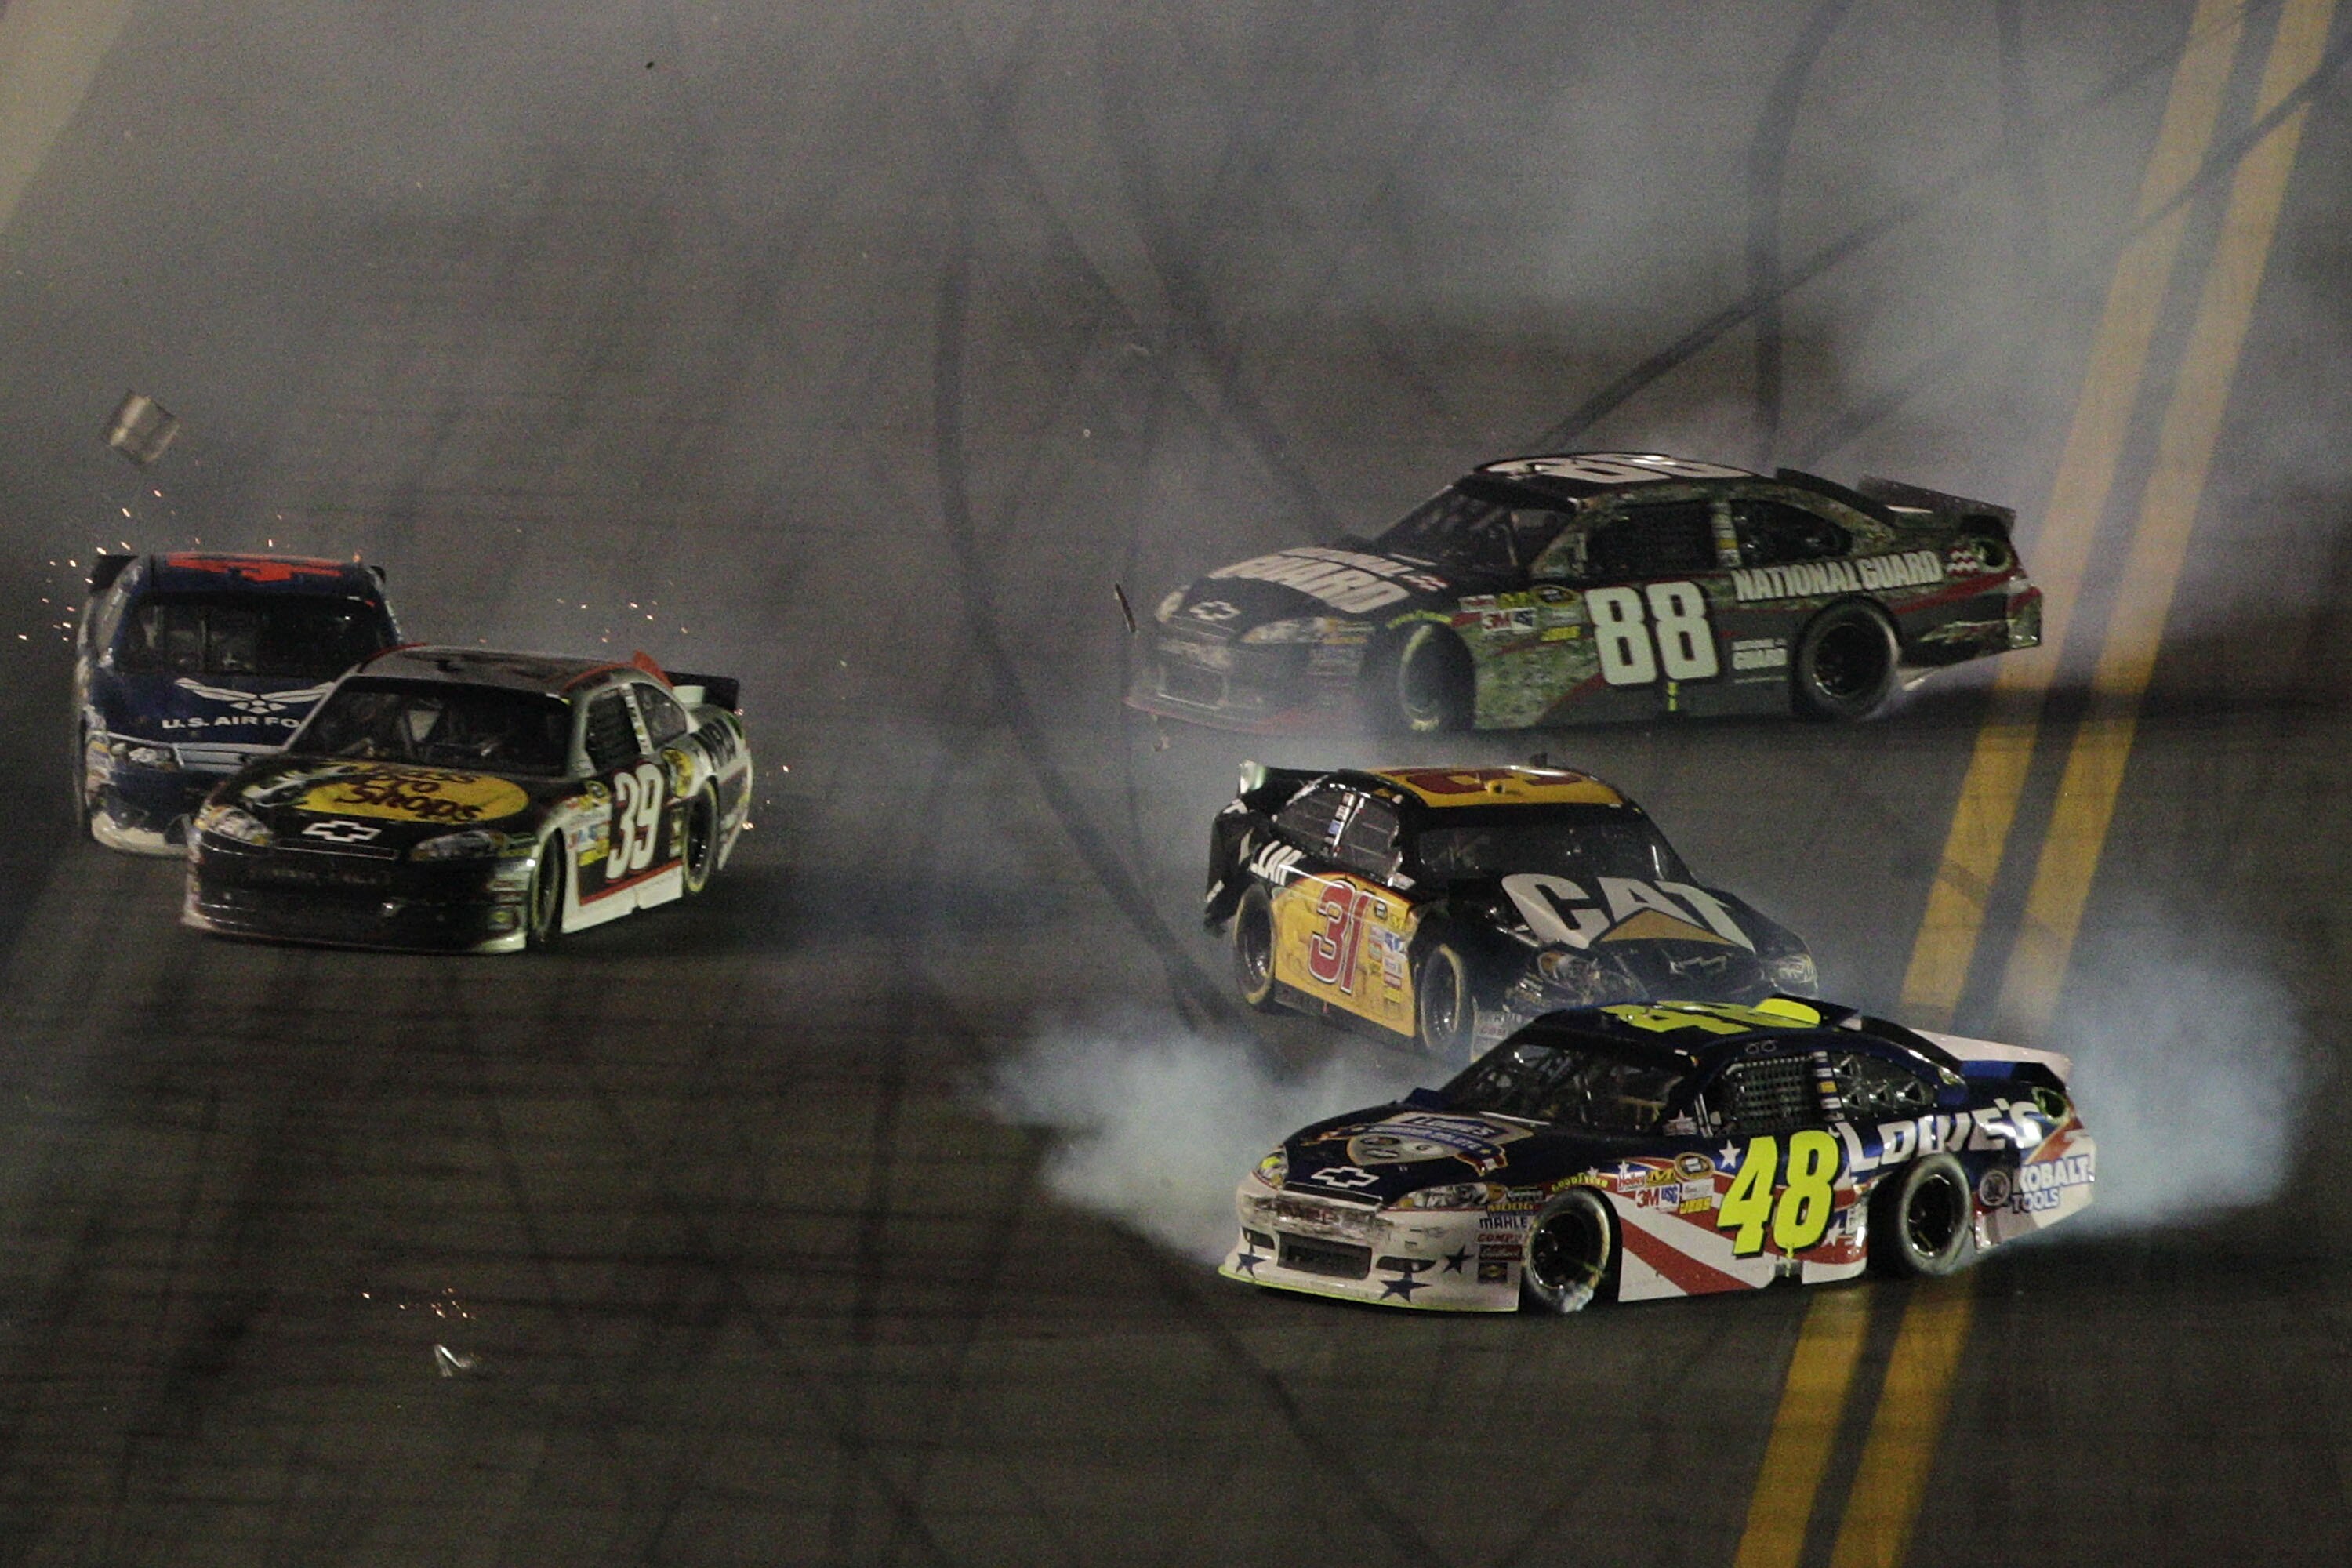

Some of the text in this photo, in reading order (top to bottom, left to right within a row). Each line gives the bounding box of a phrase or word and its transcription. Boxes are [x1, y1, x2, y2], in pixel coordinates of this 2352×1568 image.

[1584, 580, 1720, 686] 88
[162, 715, 300, 729] U.S. AIR FO
[604, 760, 666, 884] 39
[1308, 879, 1373, 995] 31
[1501, 872, 1757, 955] CAT
[1835, 1098, 2043, 1171] LOWE'S
[1636, 1187, 1660, 1208] 3M
[1717, 1129, 1840, 1257] 48
[2012, 1155, 2090, 1193] KOBALT
[2012, 1188, 2060, 1213] TOOLS
[1479, 1215, 1528, 1230] MAHLE
